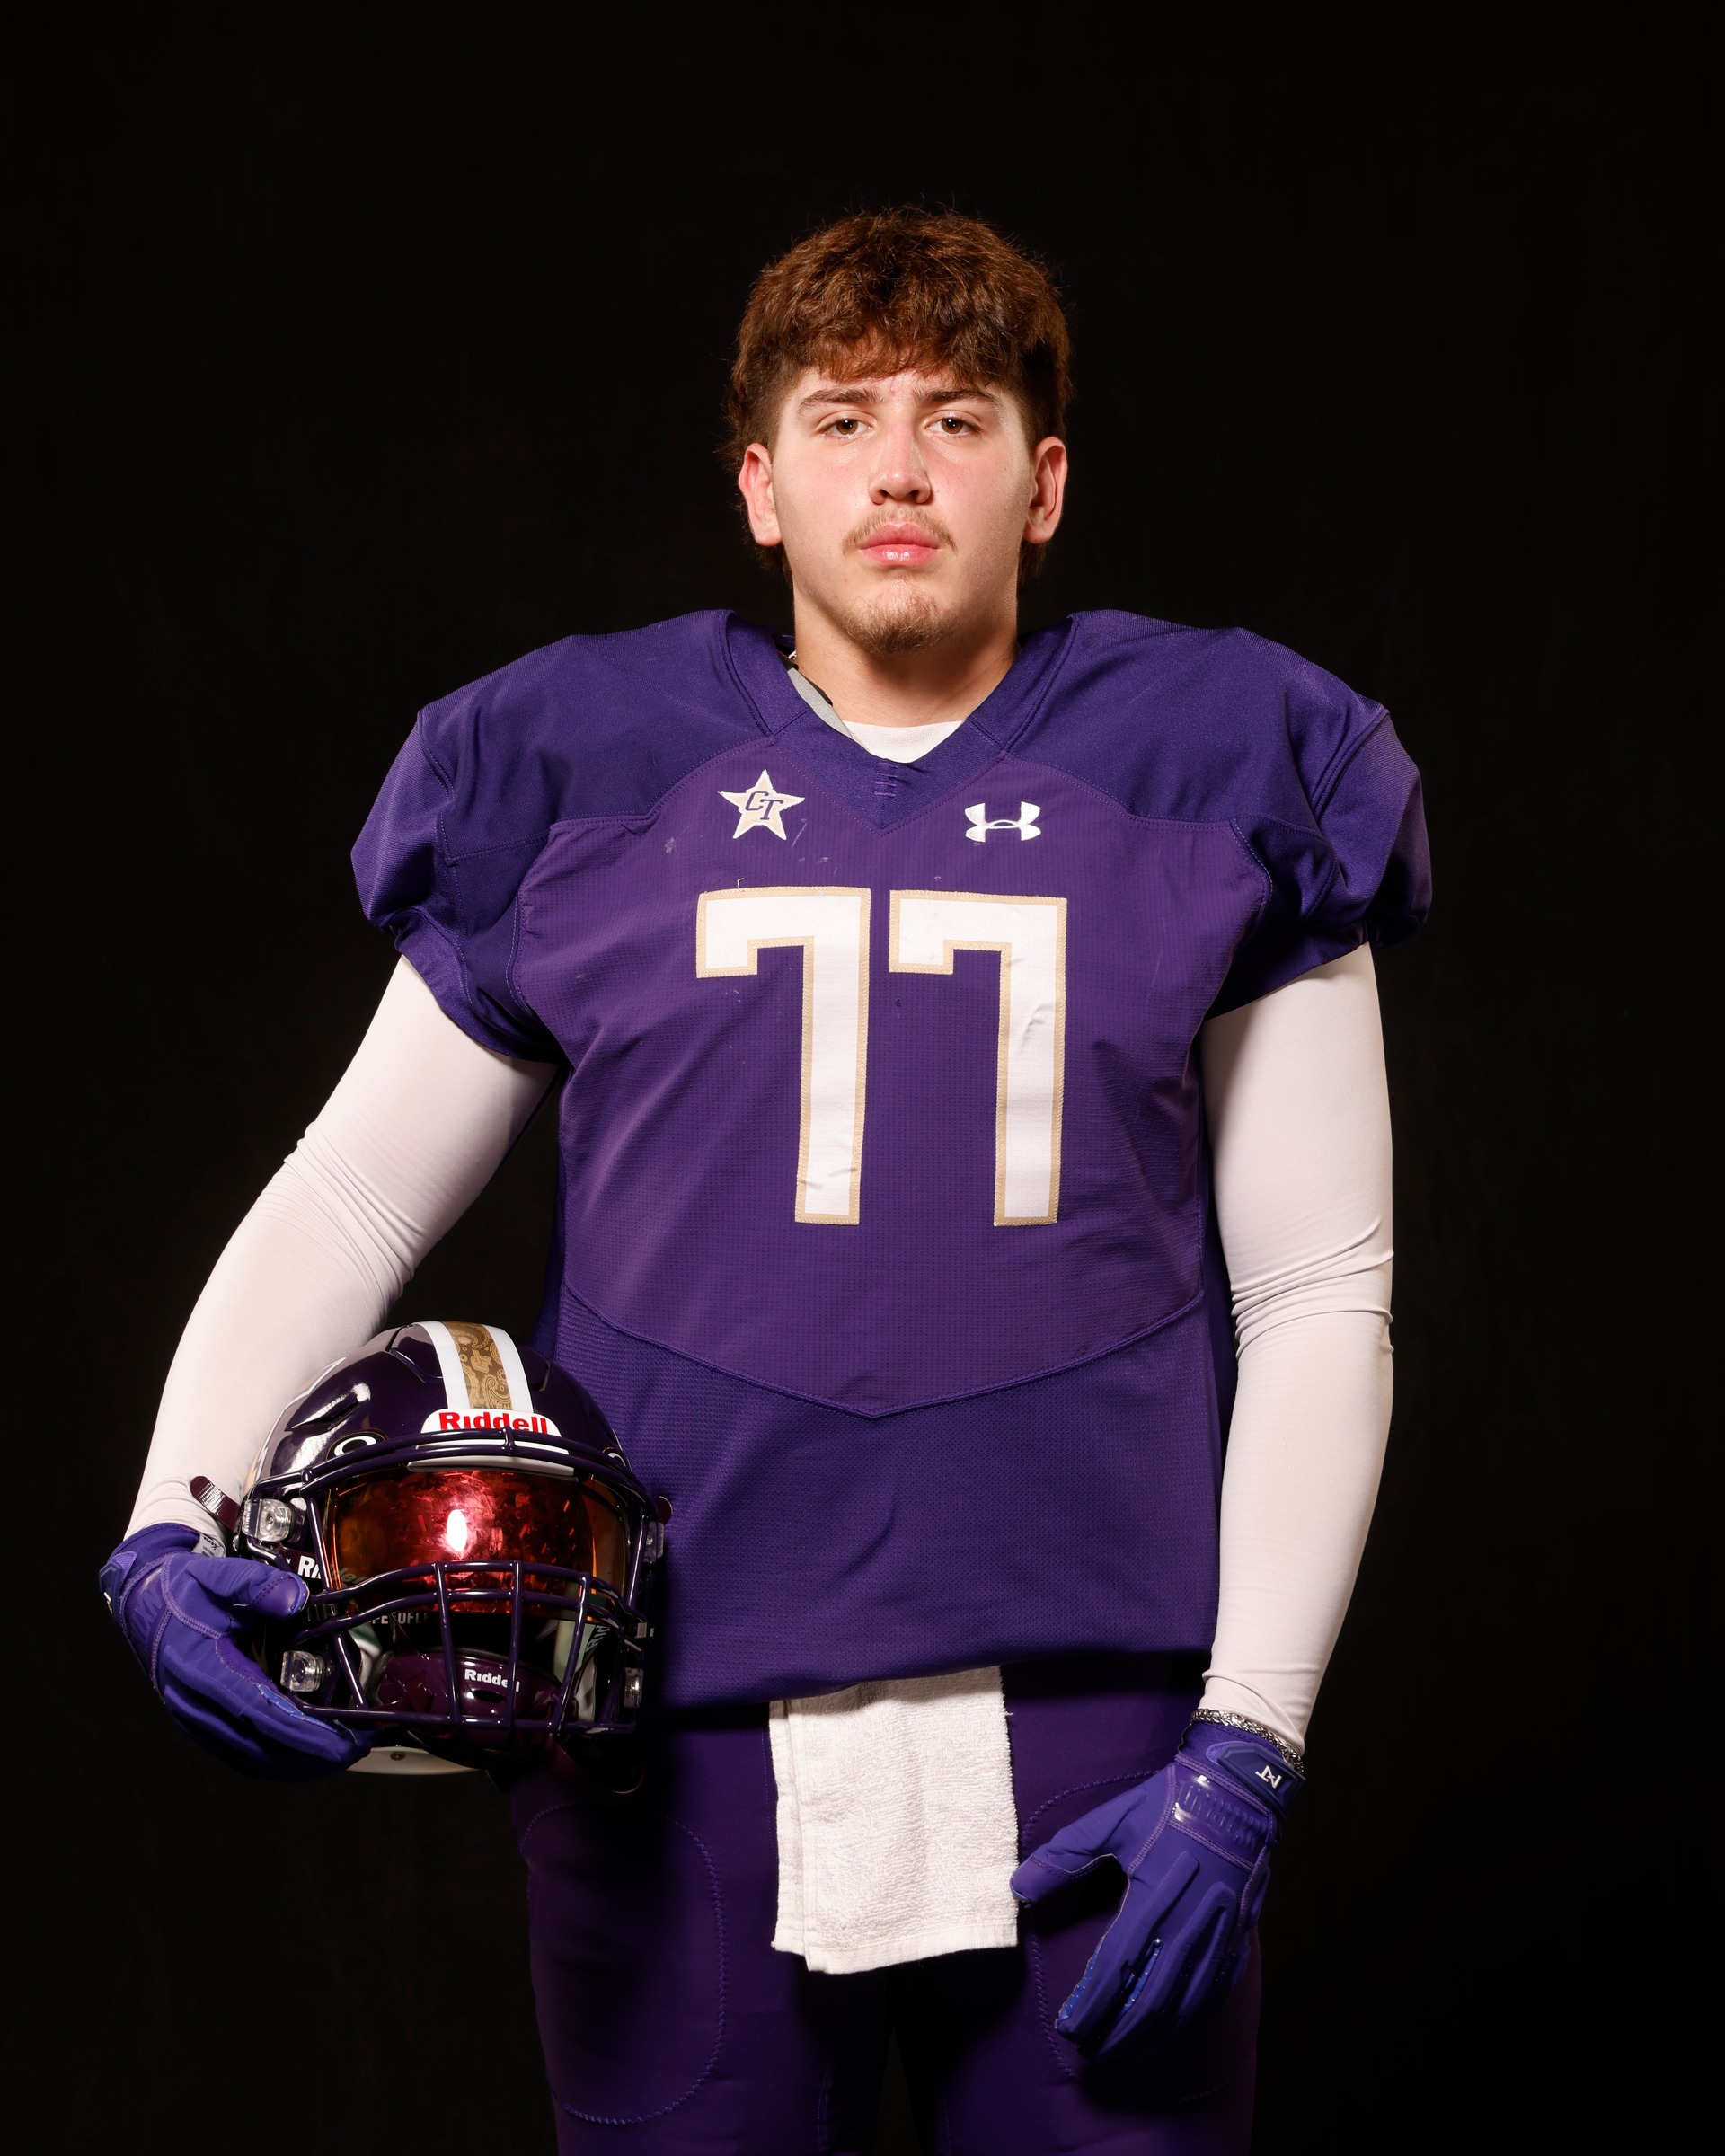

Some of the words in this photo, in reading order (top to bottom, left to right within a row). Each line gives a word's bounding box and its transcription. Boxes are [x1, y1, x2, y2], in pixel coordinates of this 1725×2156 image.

[745, 791, 784, 820] CT
[696, 885, 1068, 1227] 77
[438, 1411, 548, 1435] Riddell
[464, 1668, 520, 1692] Riddel
